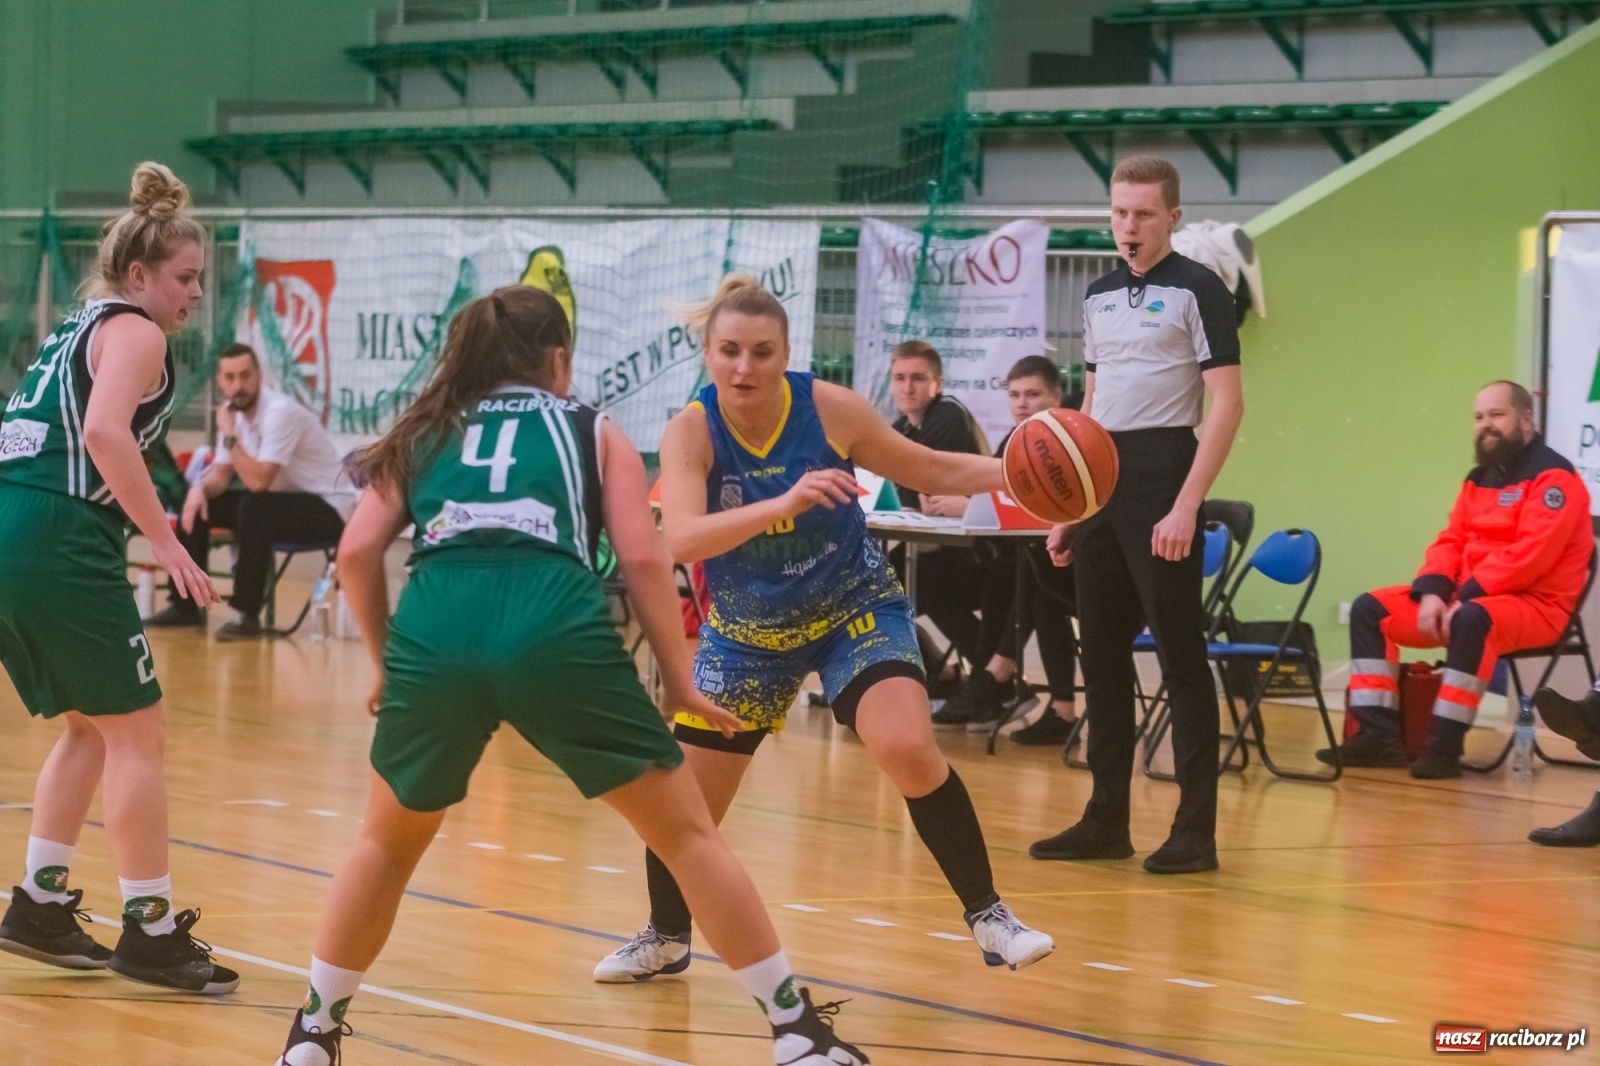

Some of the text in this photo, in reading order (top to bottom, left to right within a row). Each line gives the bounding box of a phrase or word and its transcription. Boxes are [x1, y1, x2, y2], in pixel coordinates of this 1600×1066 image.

[592, 351, 641, 408] JEST
[460, 418, 521, 494] 4
[1034, 438, 1074, 502] molten
[128, 633, 157, 685] 2
